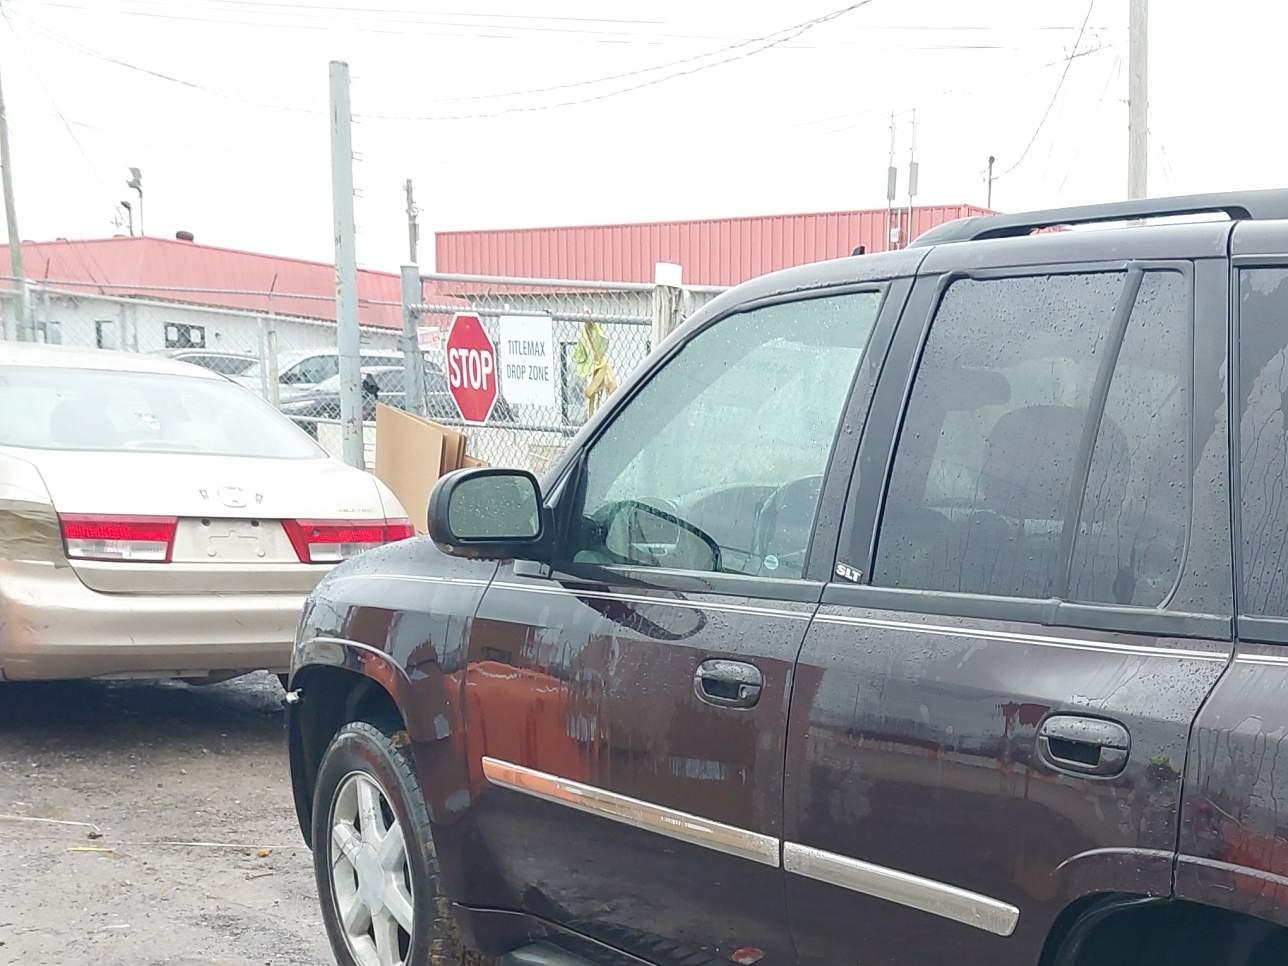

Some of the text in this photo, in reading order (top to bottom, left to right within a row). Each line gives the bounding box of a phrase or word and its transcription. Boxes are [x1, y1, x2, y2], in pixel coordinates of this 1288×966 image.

[508, 340, 546, 357] TITLEMAX
[449, 347, 493, 390] STOP
[507, 364, 549, 381] DROP ZONE
[836, 564, 861, 582] SLT
